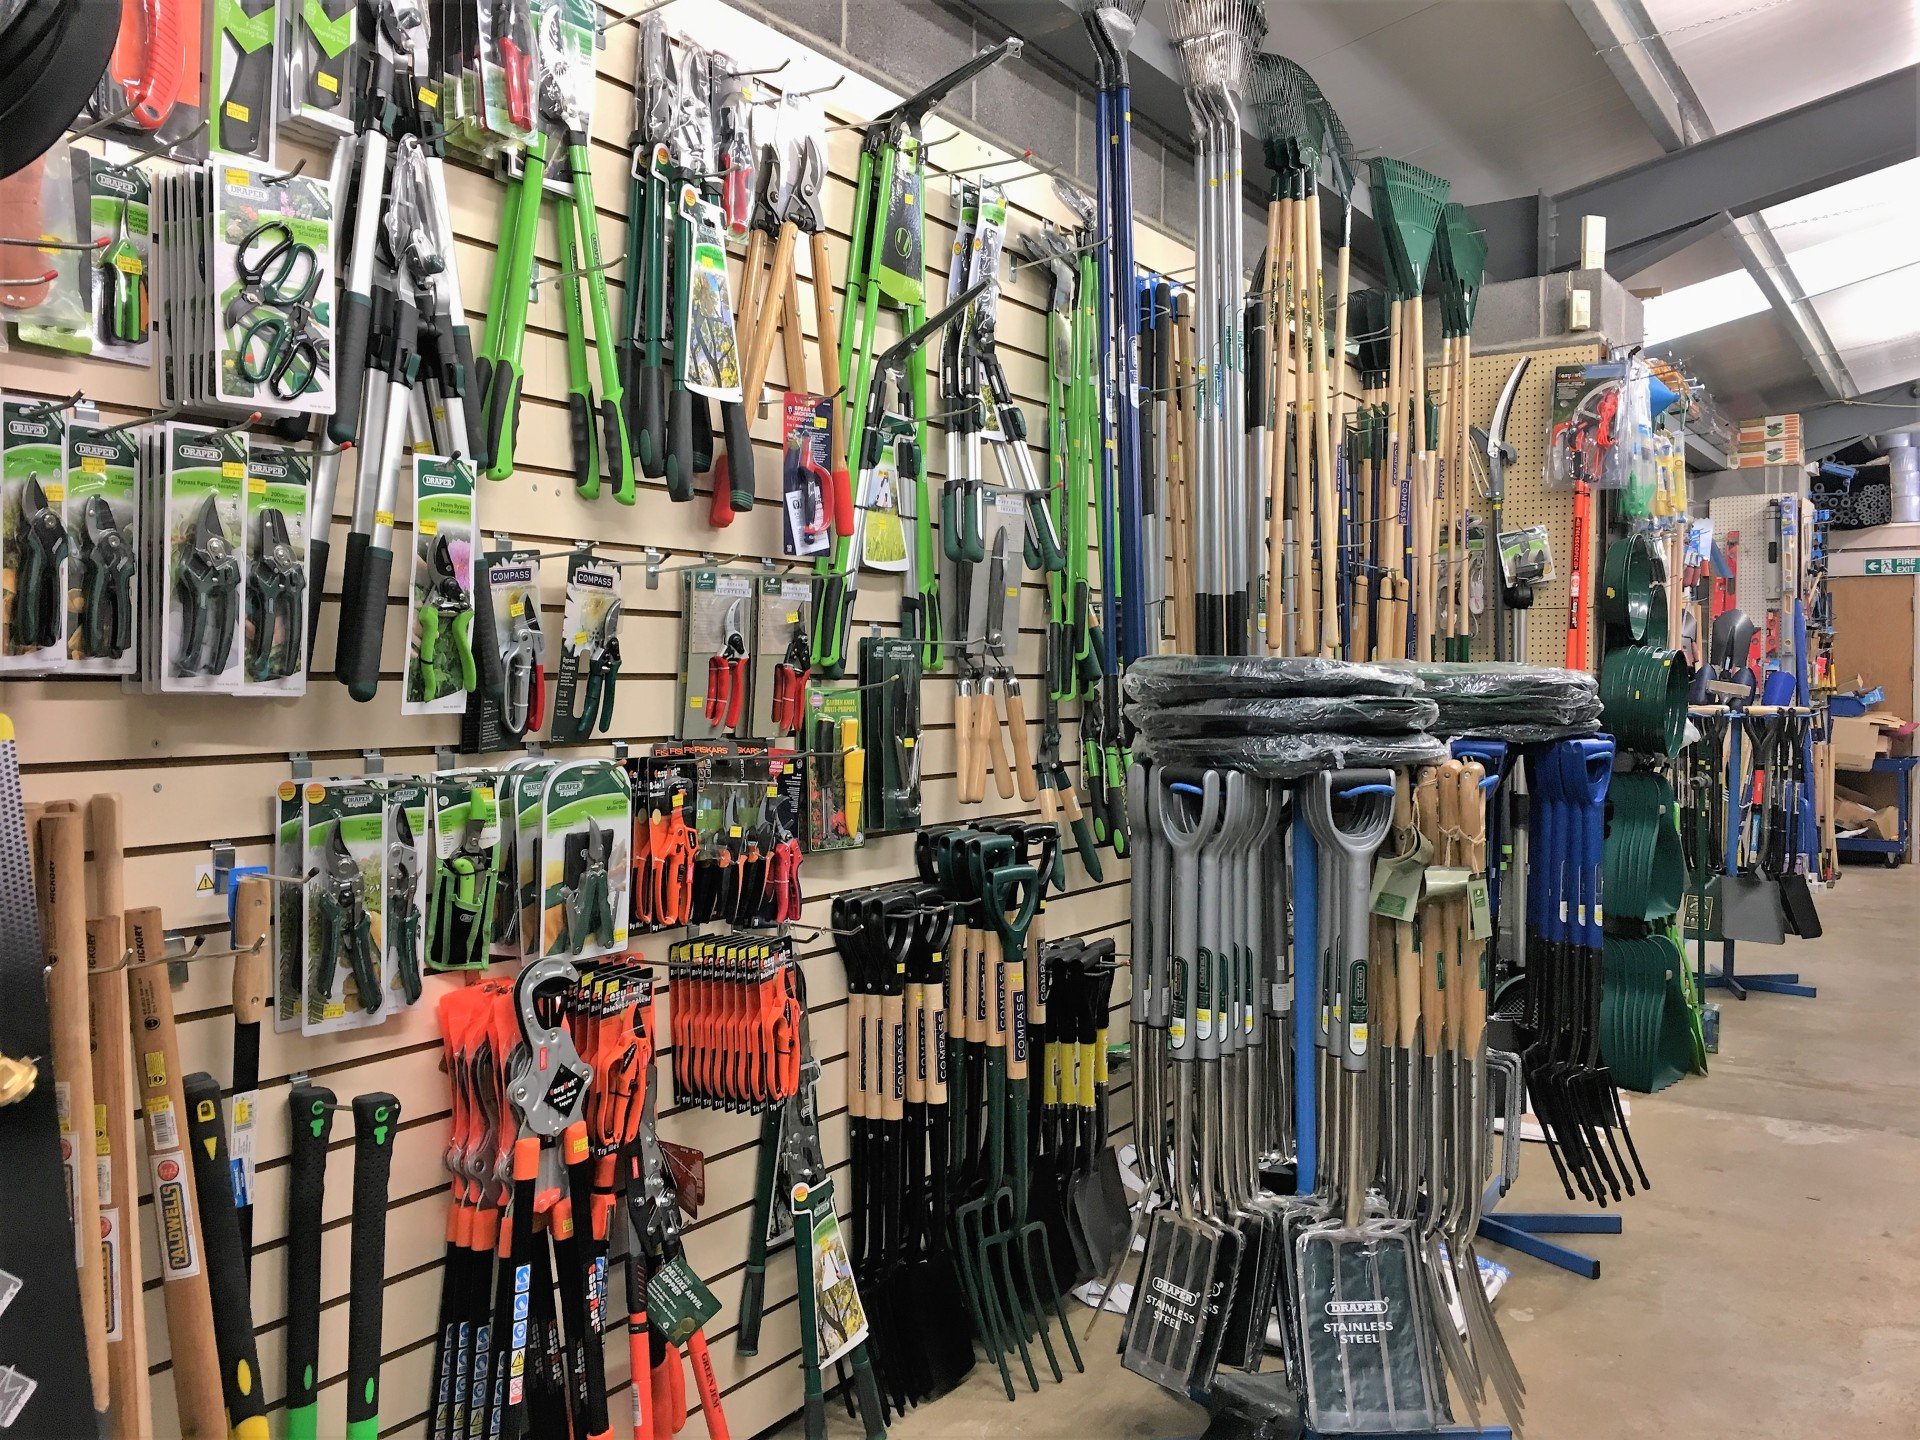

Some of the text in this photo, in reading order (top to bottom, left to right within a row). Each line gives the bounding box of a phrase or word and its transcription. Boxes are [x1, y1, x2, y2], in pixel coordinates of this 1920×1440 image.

[100, 177, 134, 192] DRAPER
[230, 185, 266, 199] DRAPER
[13, 423, 45, 435] DRAPER
[79, 445, 115, 457] DRAPER
[184, 448, 218, 459] DRAPER
[251, 465, 283, 475] DRAPER
[426, 476, 452, 486] DRAPER
[492, 570, 530, 581] COMPASS
[578, 573, 612, 587] COMPASS
[695, 746, 728, 754] FISKARS
[558, 783, 581, 791] DRAPER
[87, 933, 96, 969] ICKORY
[1016, 994, 1025, 1058] COMPASS
[938, 1013, 946, 1079] COMPASS
[598, 1147, 606, 1155] Try
[659, 1271, 682, 1297] LOPPER
[665, 1265, 703, 1310] DELUXE ANVIL
[1156, 1280, 1193, 1304] DRAPER
[1145, 1294, 1195, 1324] STAINLESS
[1330, 1302, 1383, 1313] DRAPER
[1153, 1310, 1181, 1331] STEEL
[1323, 1321, 1394, 1333] STAINLESS
[1340, 1334, 1380, 1344] STEEL
[701, 1352, 720, 1408] GREEN JEM
